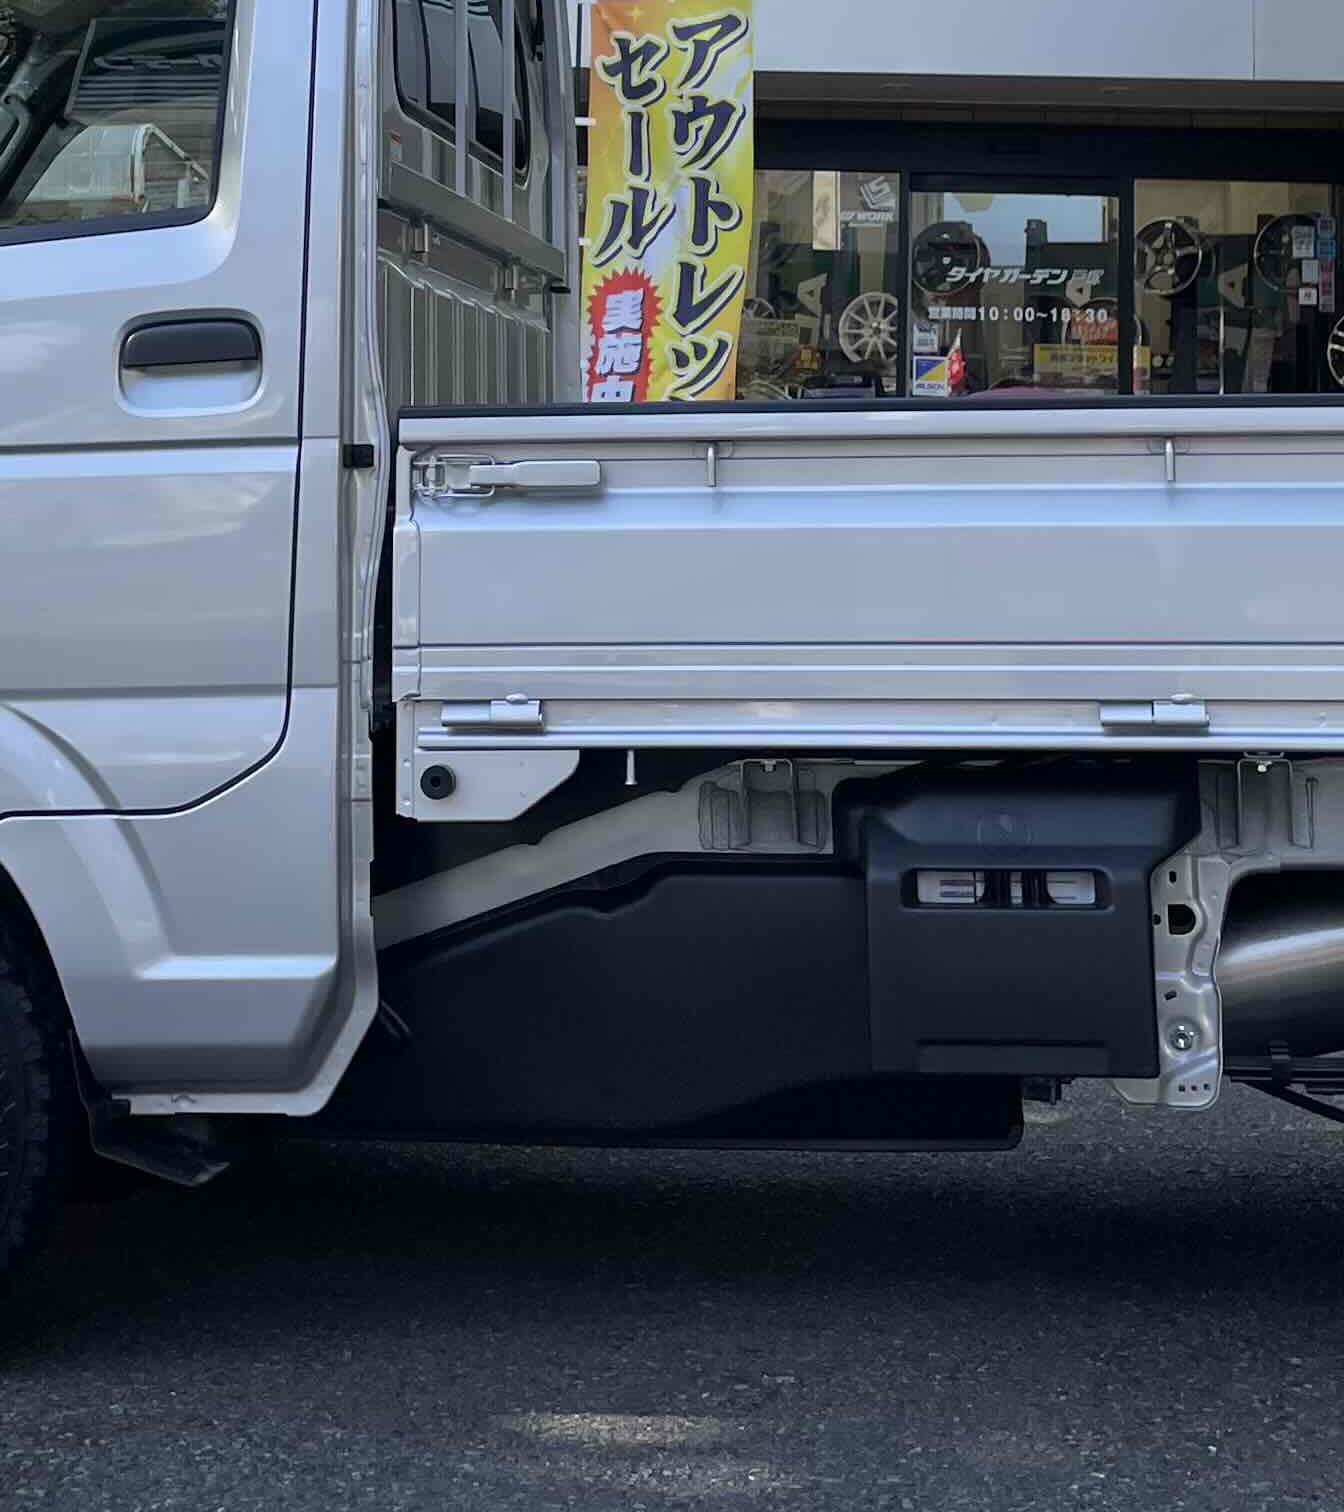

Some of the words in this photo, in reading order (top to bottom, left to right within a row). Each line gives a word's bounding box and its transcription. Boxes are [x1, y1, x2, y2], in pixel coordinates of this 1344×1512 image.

[595, 35, 668, 266] セール
[669, 11, 746, 401] アウトレッ
[945, 266, 1069, 285] タイヤガーデン
